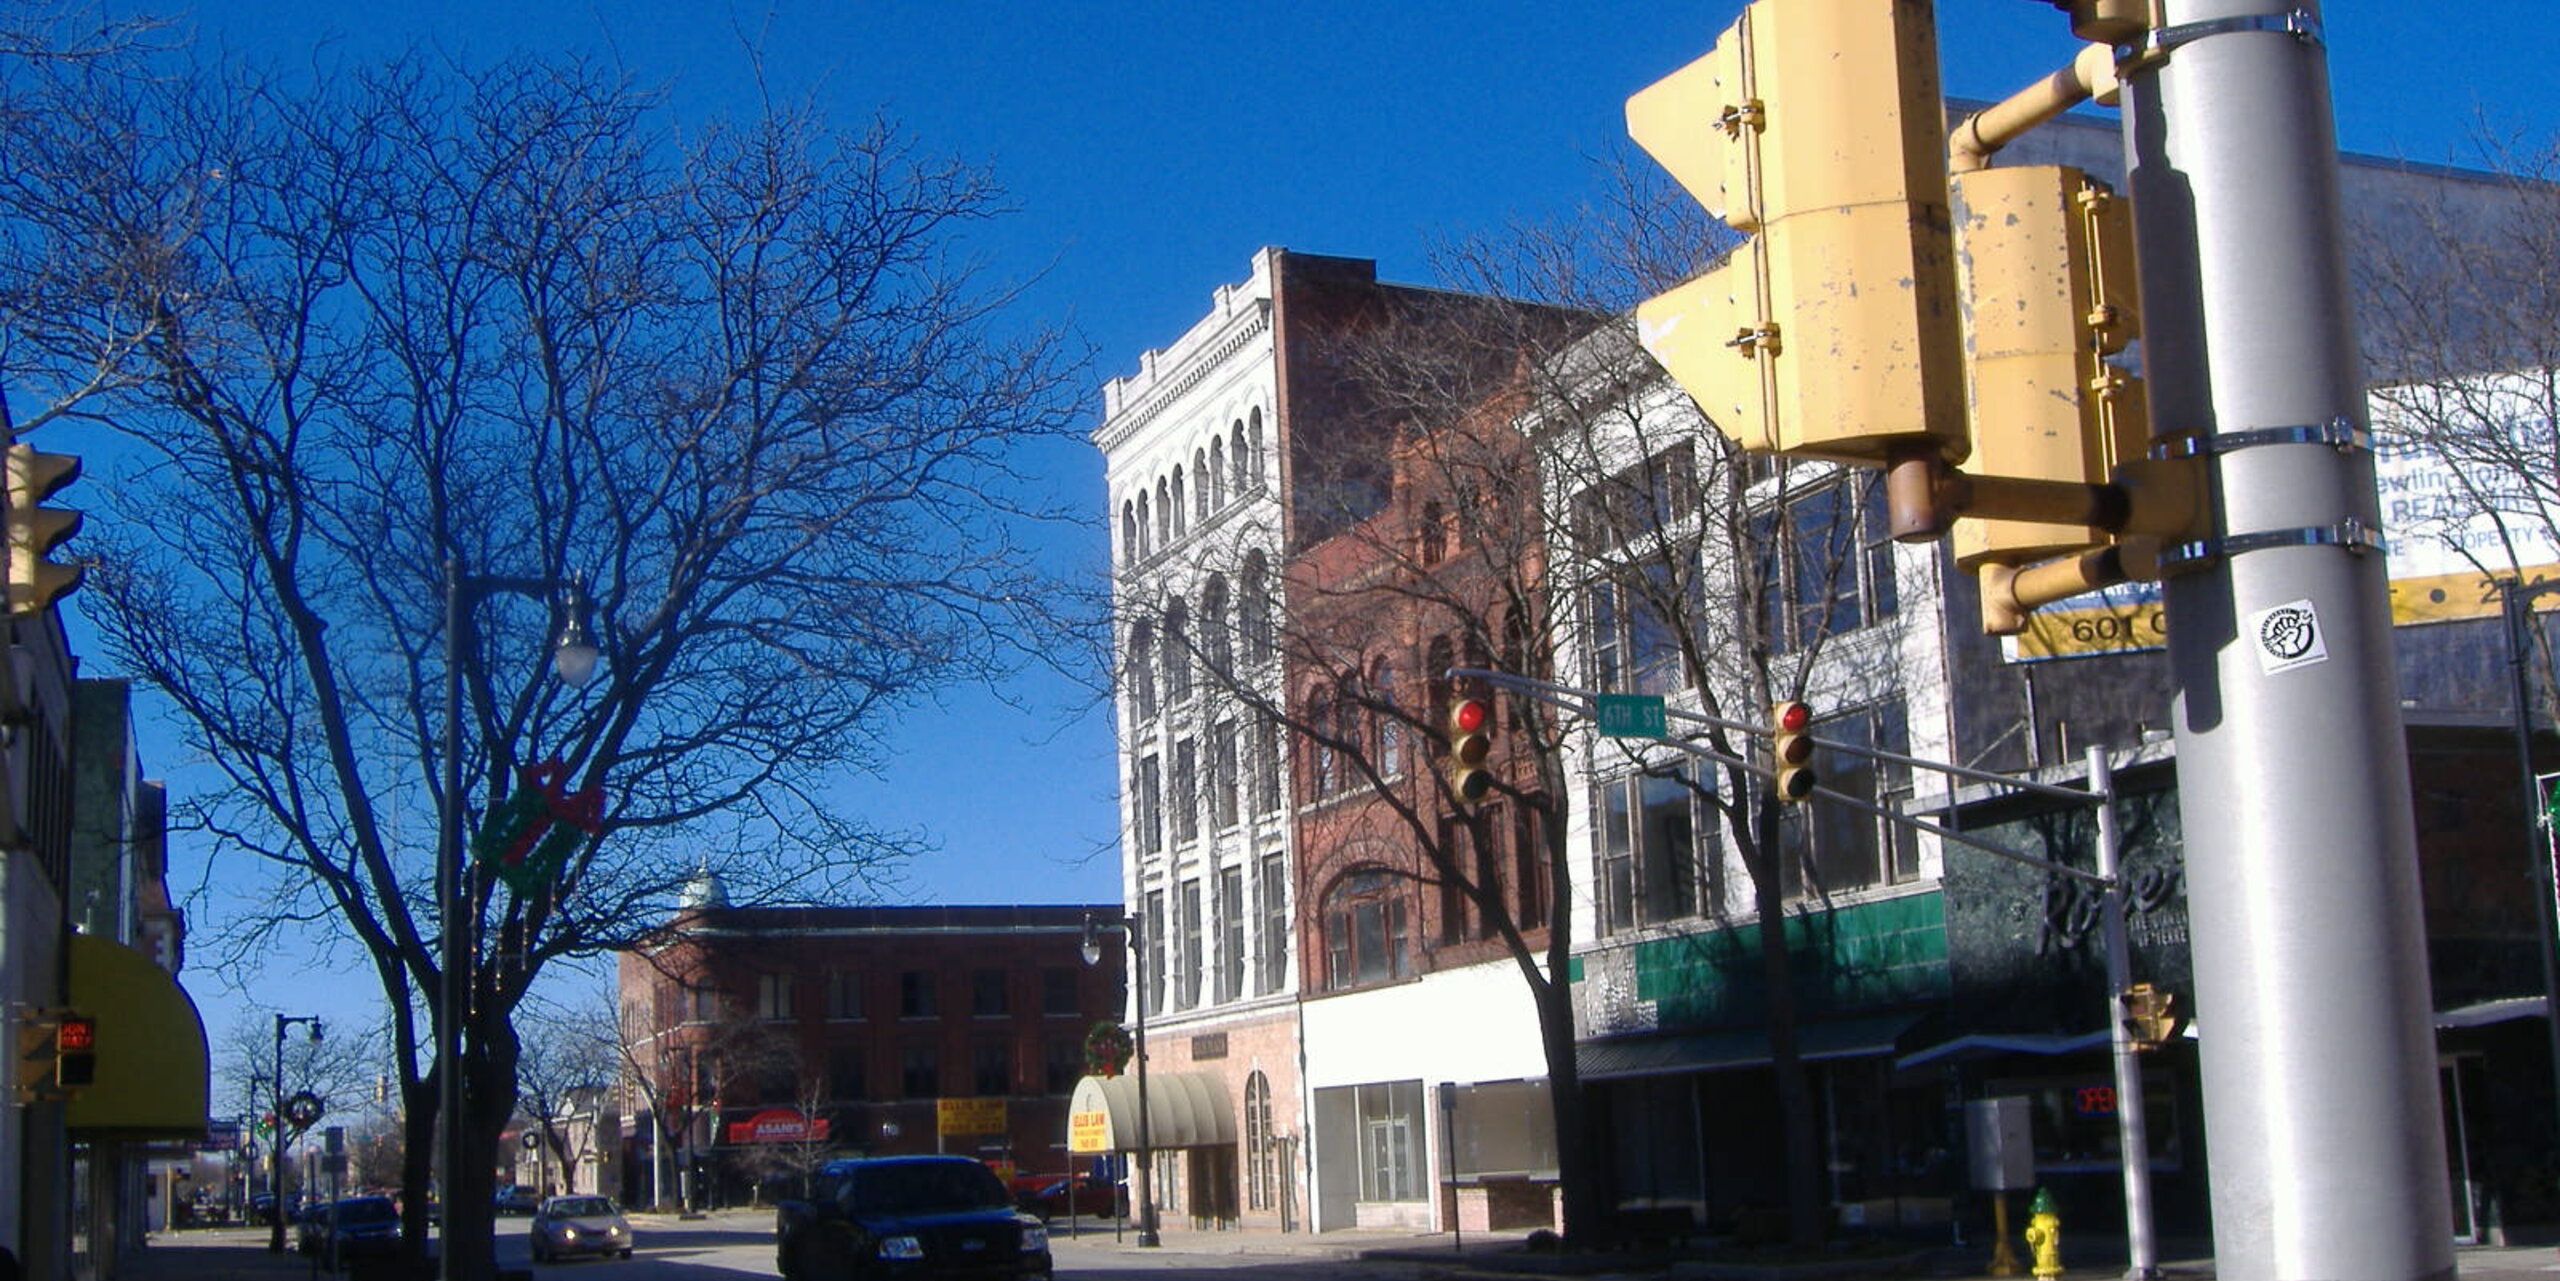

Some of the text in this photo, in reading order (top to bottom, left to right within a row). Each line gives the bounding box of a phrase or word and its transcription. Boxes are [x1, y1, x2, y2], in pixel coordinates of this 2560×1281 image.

[2073, 617, 2132, 642] 601
[1604, 703, 1660, 727] 6TH ST
